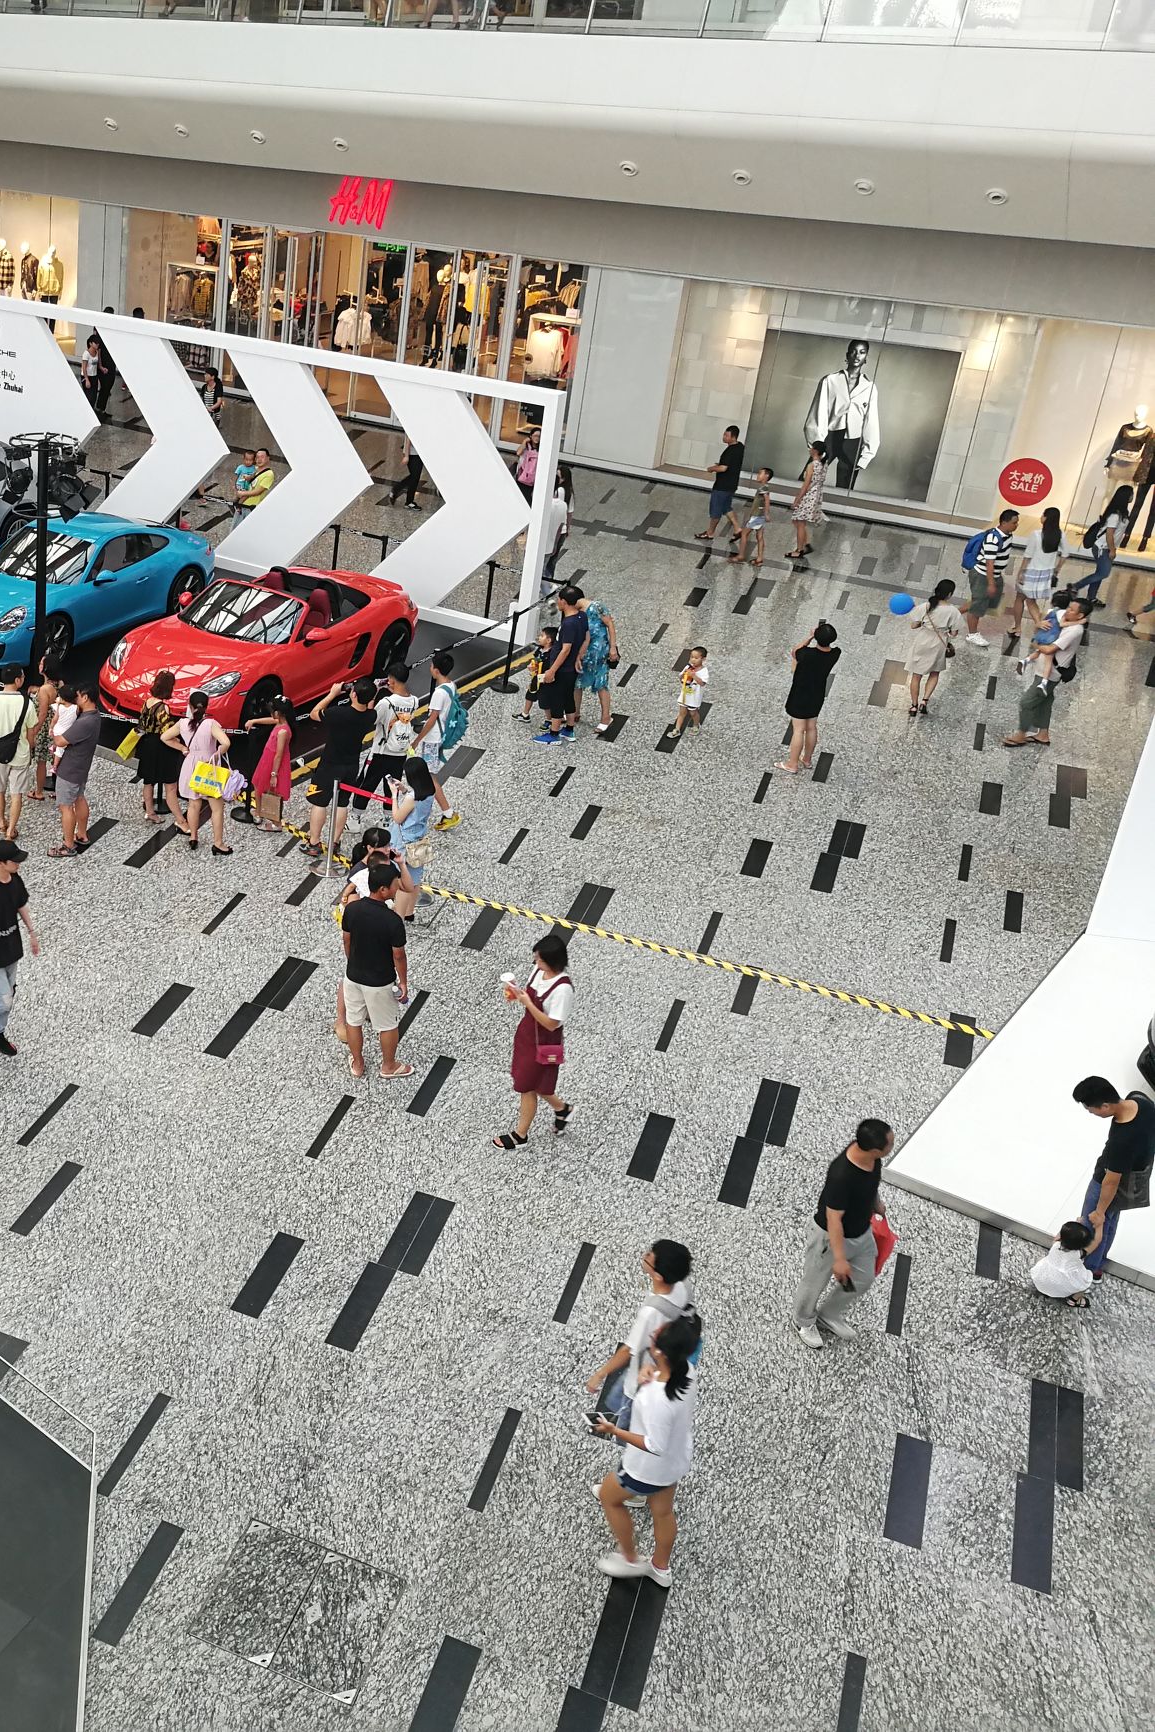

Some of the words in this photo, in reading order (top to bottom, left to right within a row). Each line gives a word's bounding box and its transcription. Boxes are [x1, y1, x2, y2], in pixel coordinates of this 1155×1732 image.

[329, 176, 393, 230] H&M
[3, 382, 24, 393] Zhuhai
[1008, 469, 1045, 485] 大减价
[1010, 481, 1038, 493] SALE
[100, 711, 139, 724] ORSCHE
